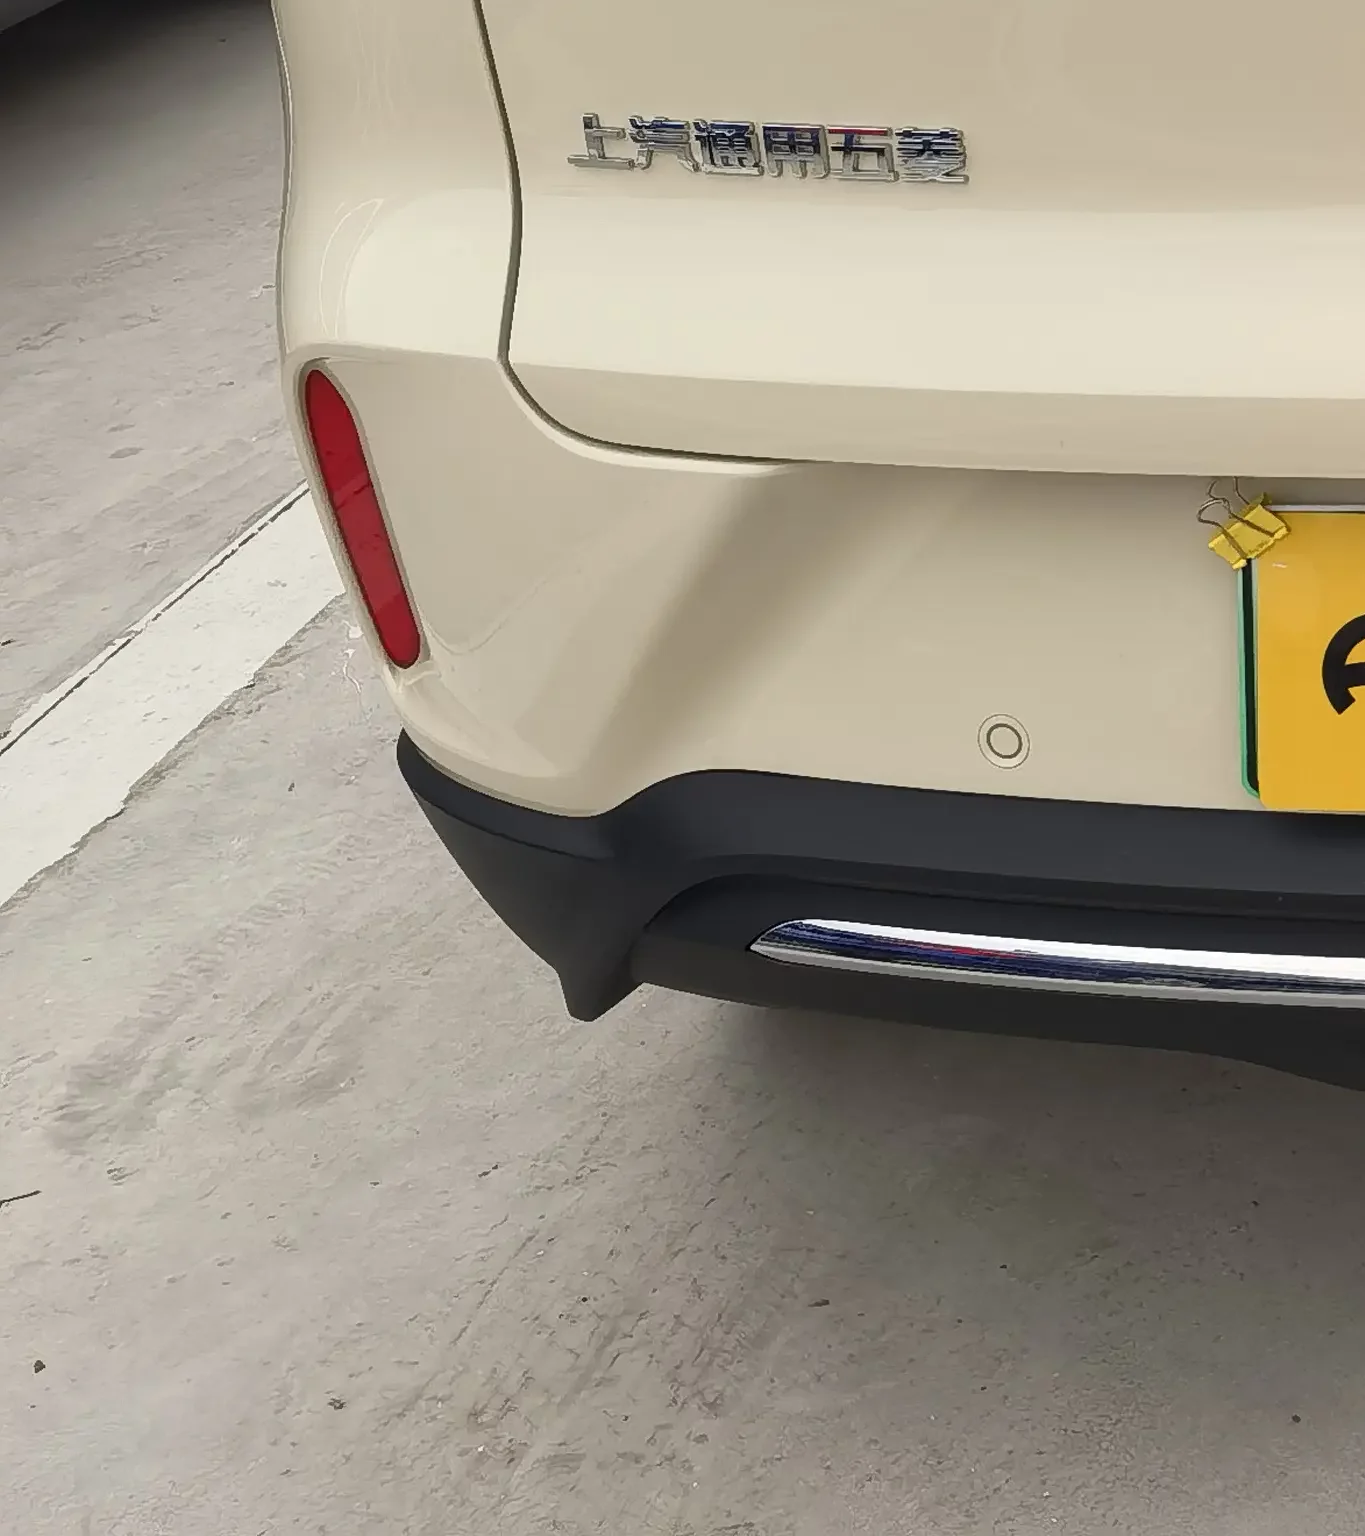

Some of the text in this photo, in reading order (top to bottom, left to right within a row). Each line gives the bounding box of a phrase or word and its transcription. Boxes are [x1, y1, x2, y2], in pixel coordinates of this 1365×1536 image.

[566, 112, 969, 183] 上汽通用五菱
